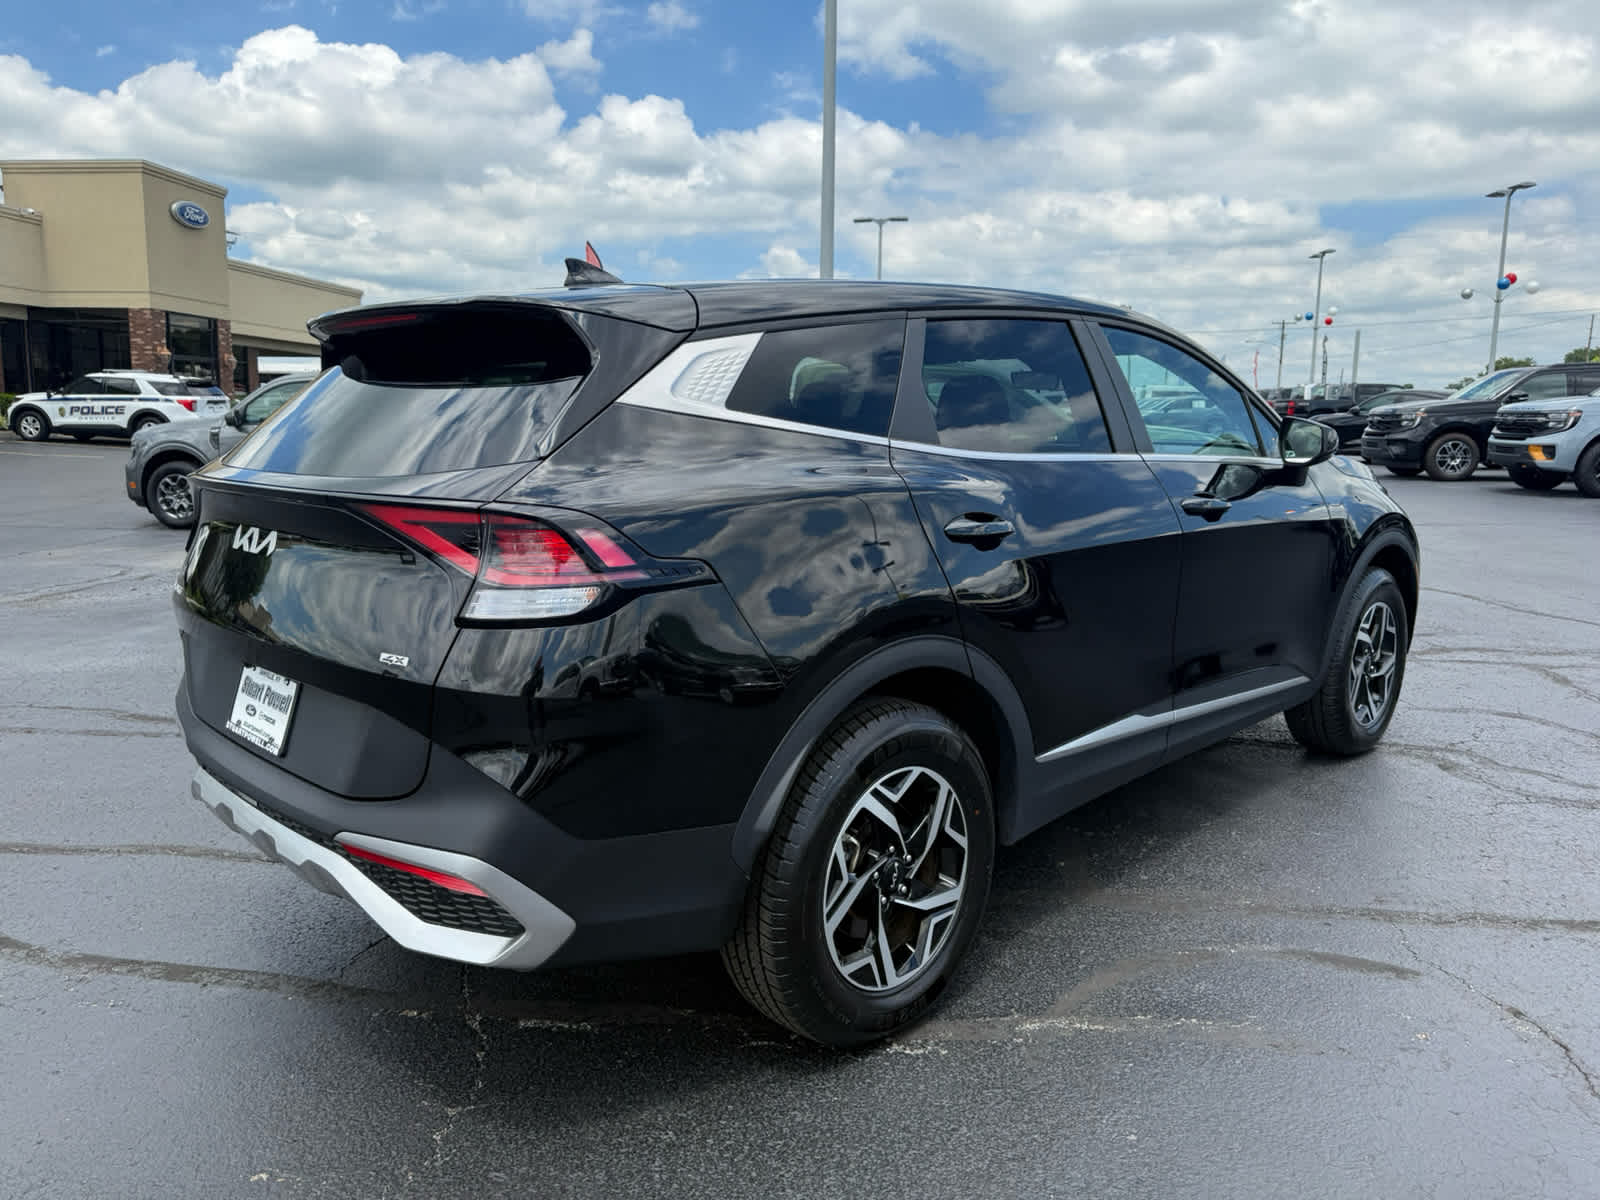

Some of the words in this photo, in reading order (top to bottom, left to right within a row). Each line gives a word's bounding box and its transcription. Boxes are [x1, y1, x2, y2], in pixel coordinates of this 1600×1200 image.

[184, 206, 205, 223] Ford
[70, 405, 126, 415] POLICE
[232, 523, 278, 557] KIA
[241, 675, 264, 703] Stuart
[263, 685, 292, 714] Powell
